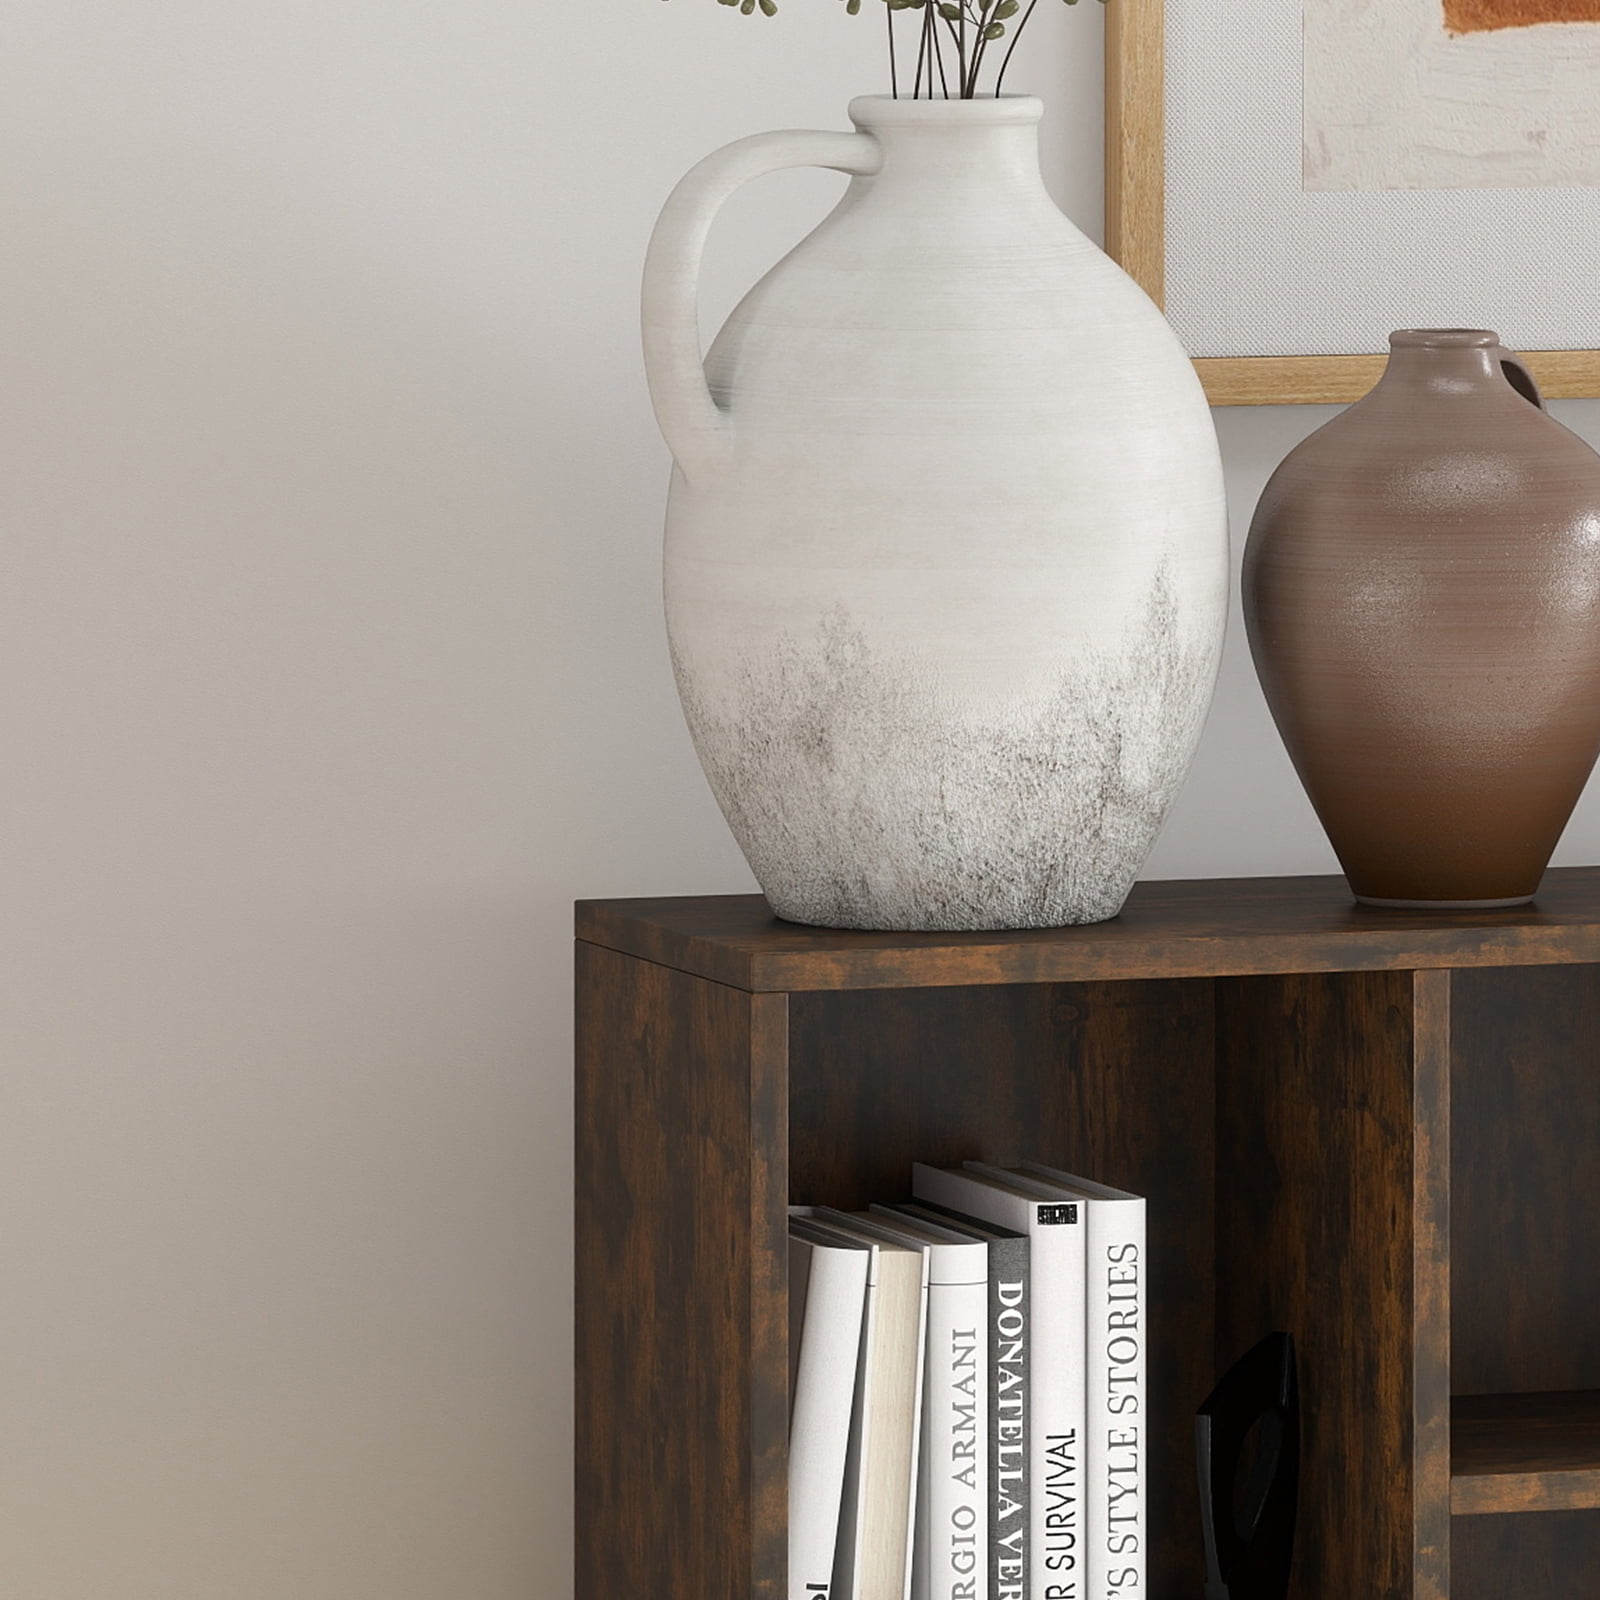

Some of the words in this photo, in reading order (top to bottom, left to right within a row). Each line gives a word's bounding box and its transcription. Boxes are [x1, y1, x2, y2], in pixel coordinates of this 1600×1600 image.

[951, 1328, 976, 1489] ARMANI
[997, 1280, 1023, 1522] DONATELLA
[1107, 1243, 1138, 1413] STORIES
[1045, 1428, 1077, 1570] SURVIVAL
[1107, 1427, 1138, 1554] STYLE
